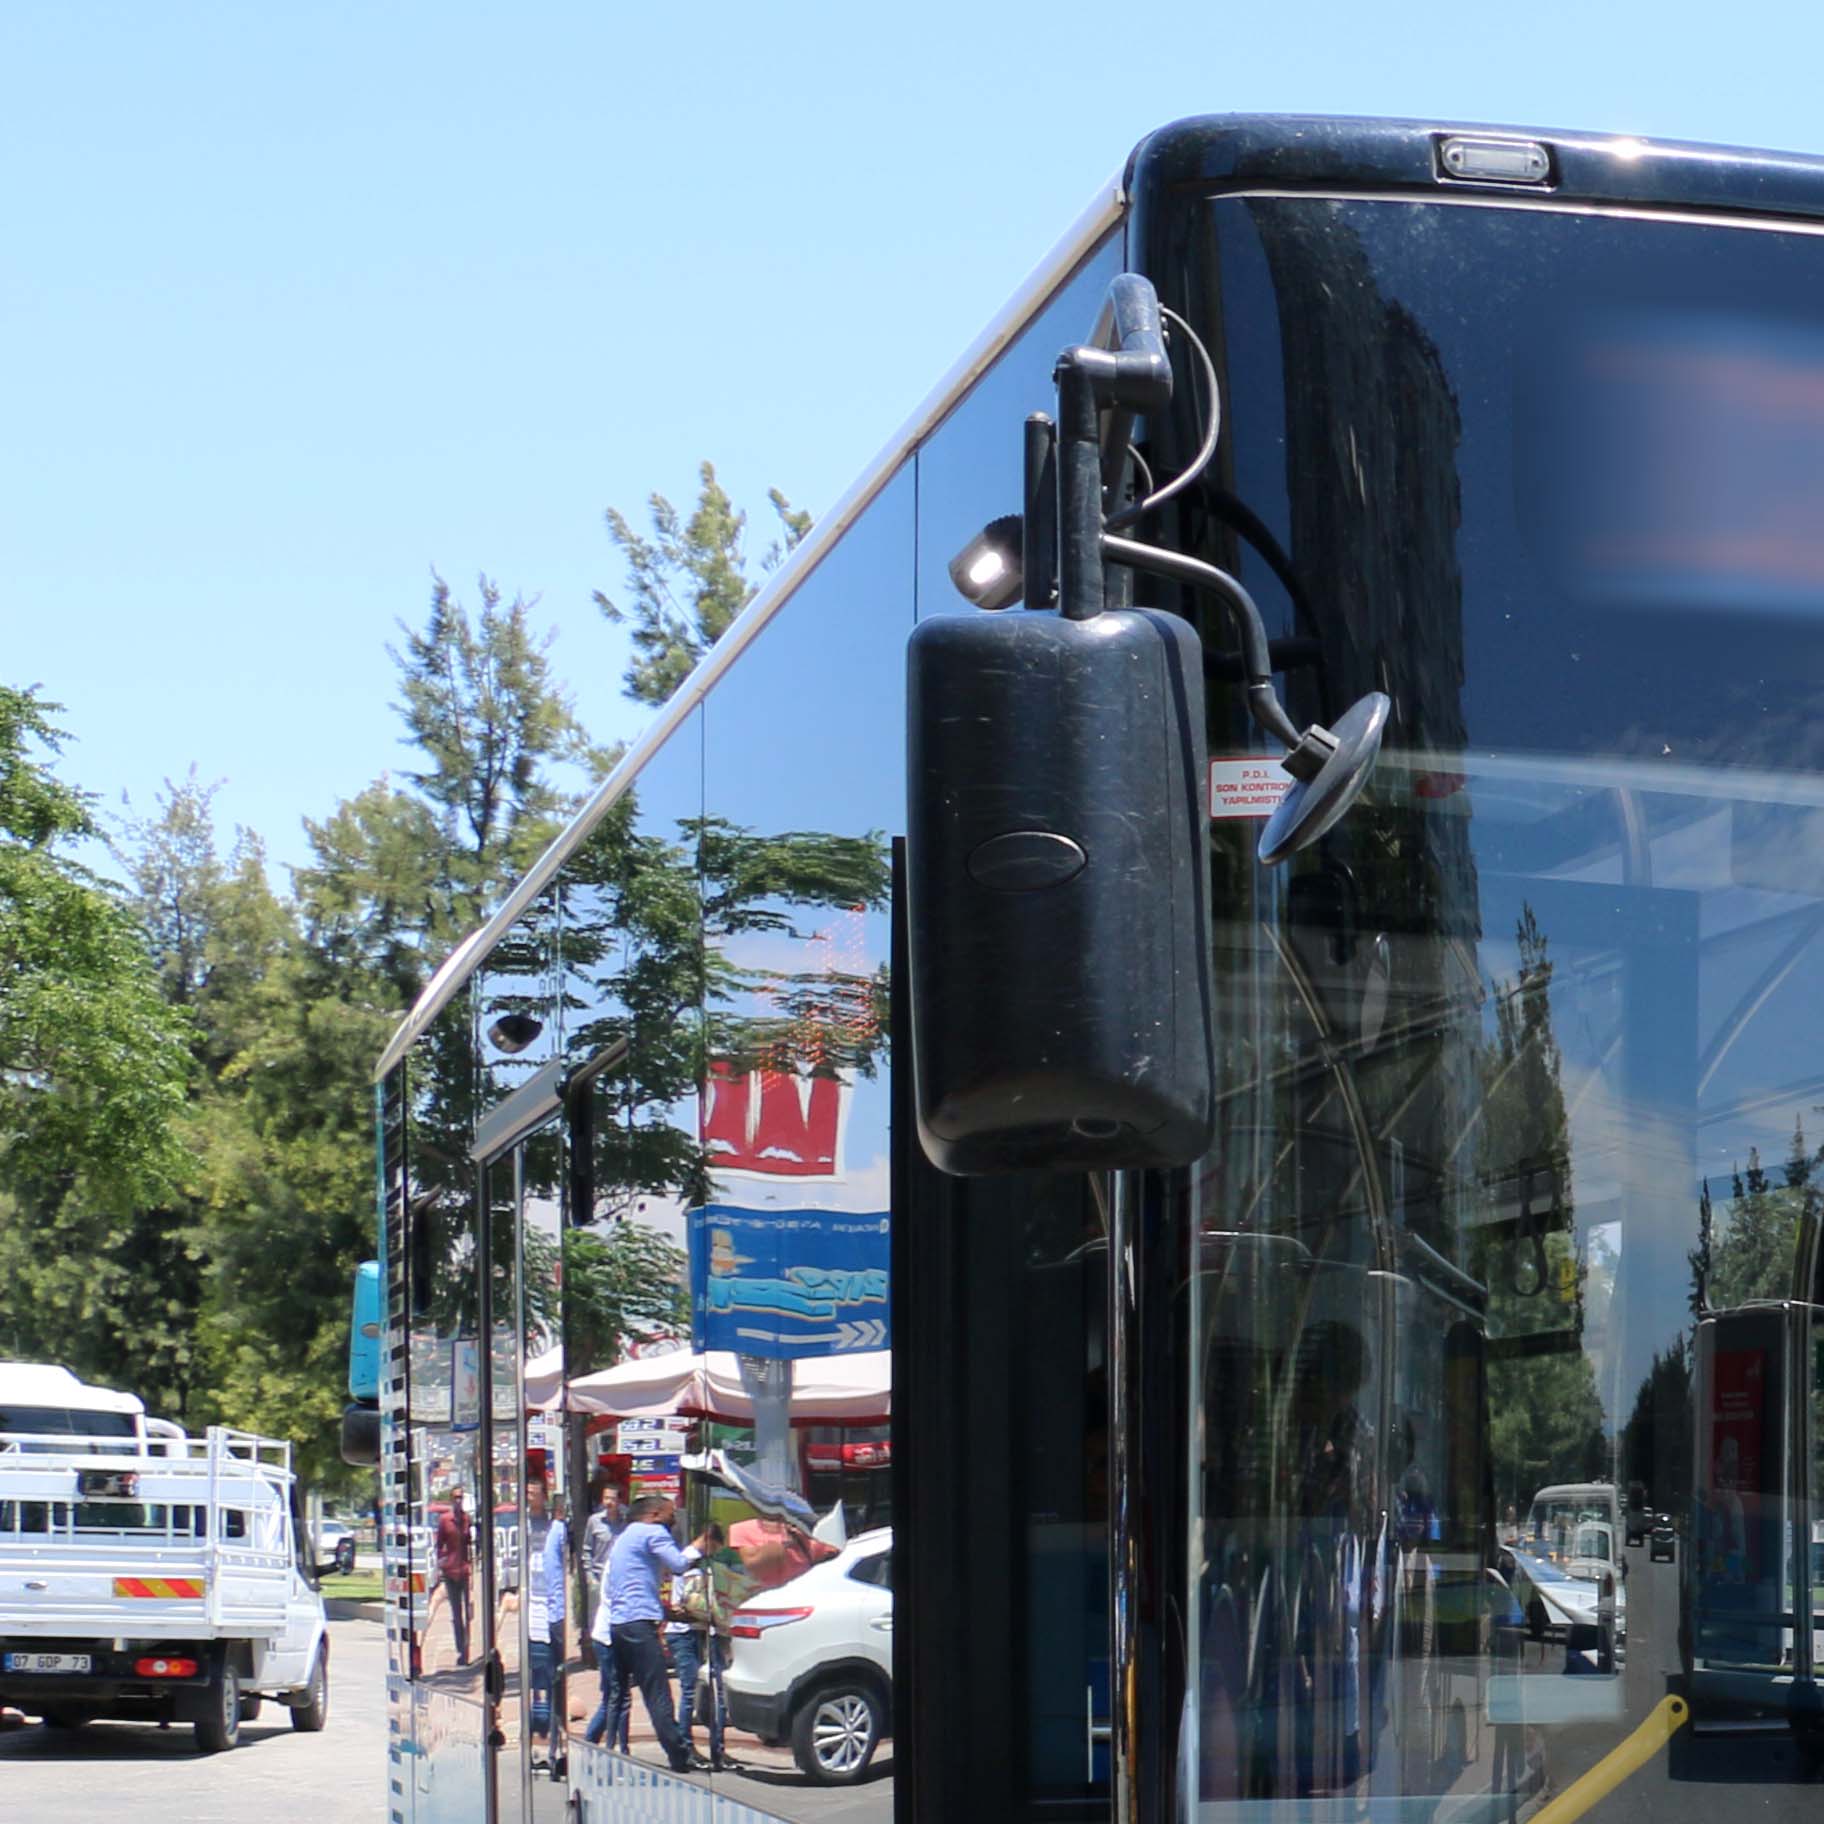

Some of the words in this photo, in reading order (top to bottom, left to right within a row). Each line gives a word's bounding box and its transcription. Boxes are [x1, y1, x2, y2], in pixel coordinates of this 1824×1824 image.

[1216, 784, 1238, 792] SON
[14, 1655, 29, 1668] 07
[72, 1656, 89, 1670] 73
